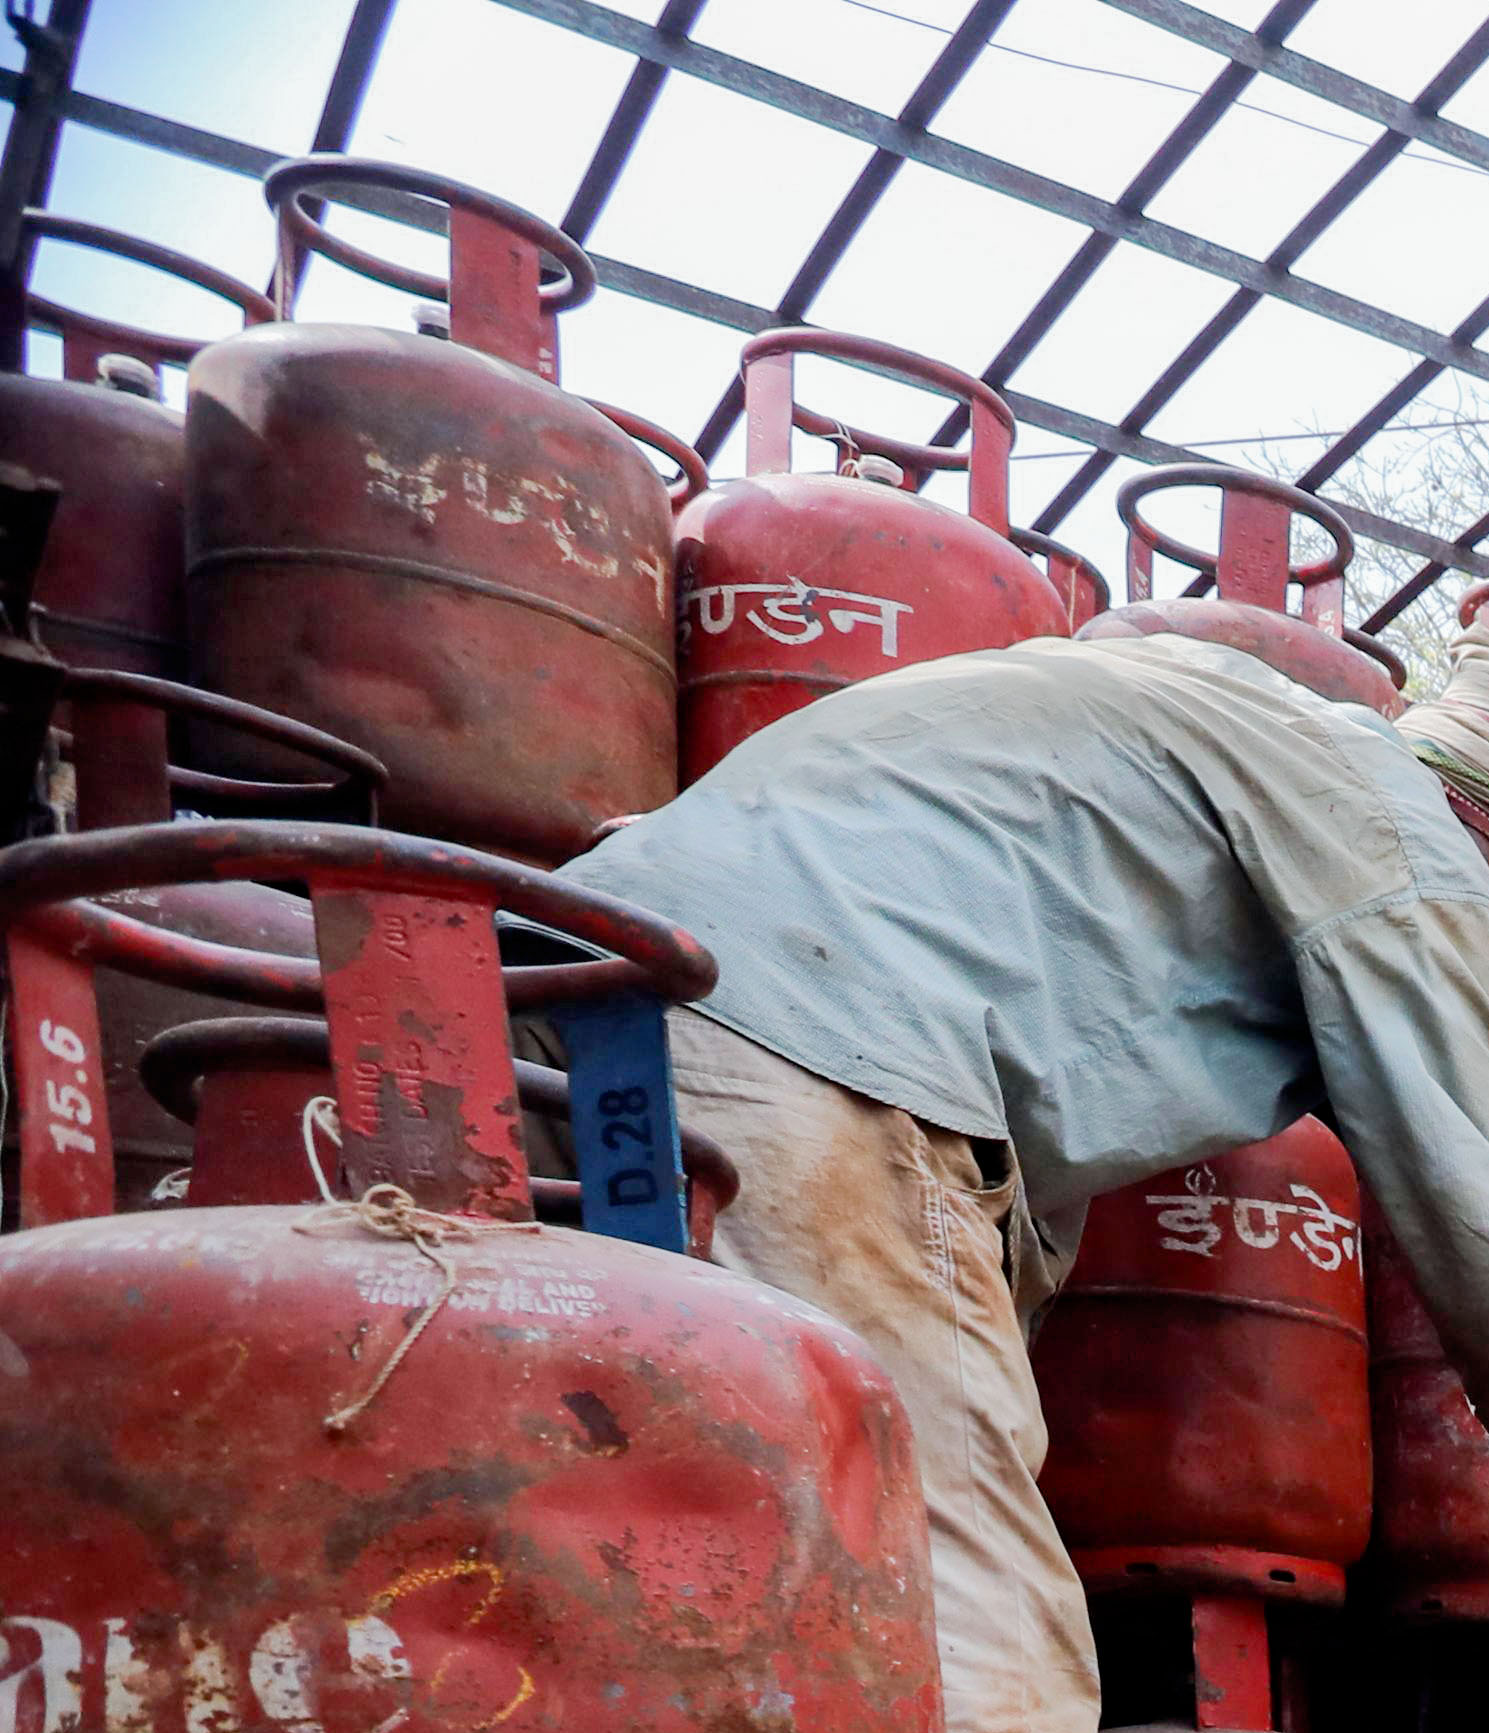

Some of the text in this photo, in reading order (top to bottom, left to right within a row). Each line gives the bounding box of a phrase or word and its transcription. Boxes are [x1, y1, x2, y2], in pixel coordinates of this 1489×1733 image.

[680, 576, 913, 658] ण्डेन
[39, 1018, 97, 1154] 15.6
[606, 1085, 652, 1207] D.28
